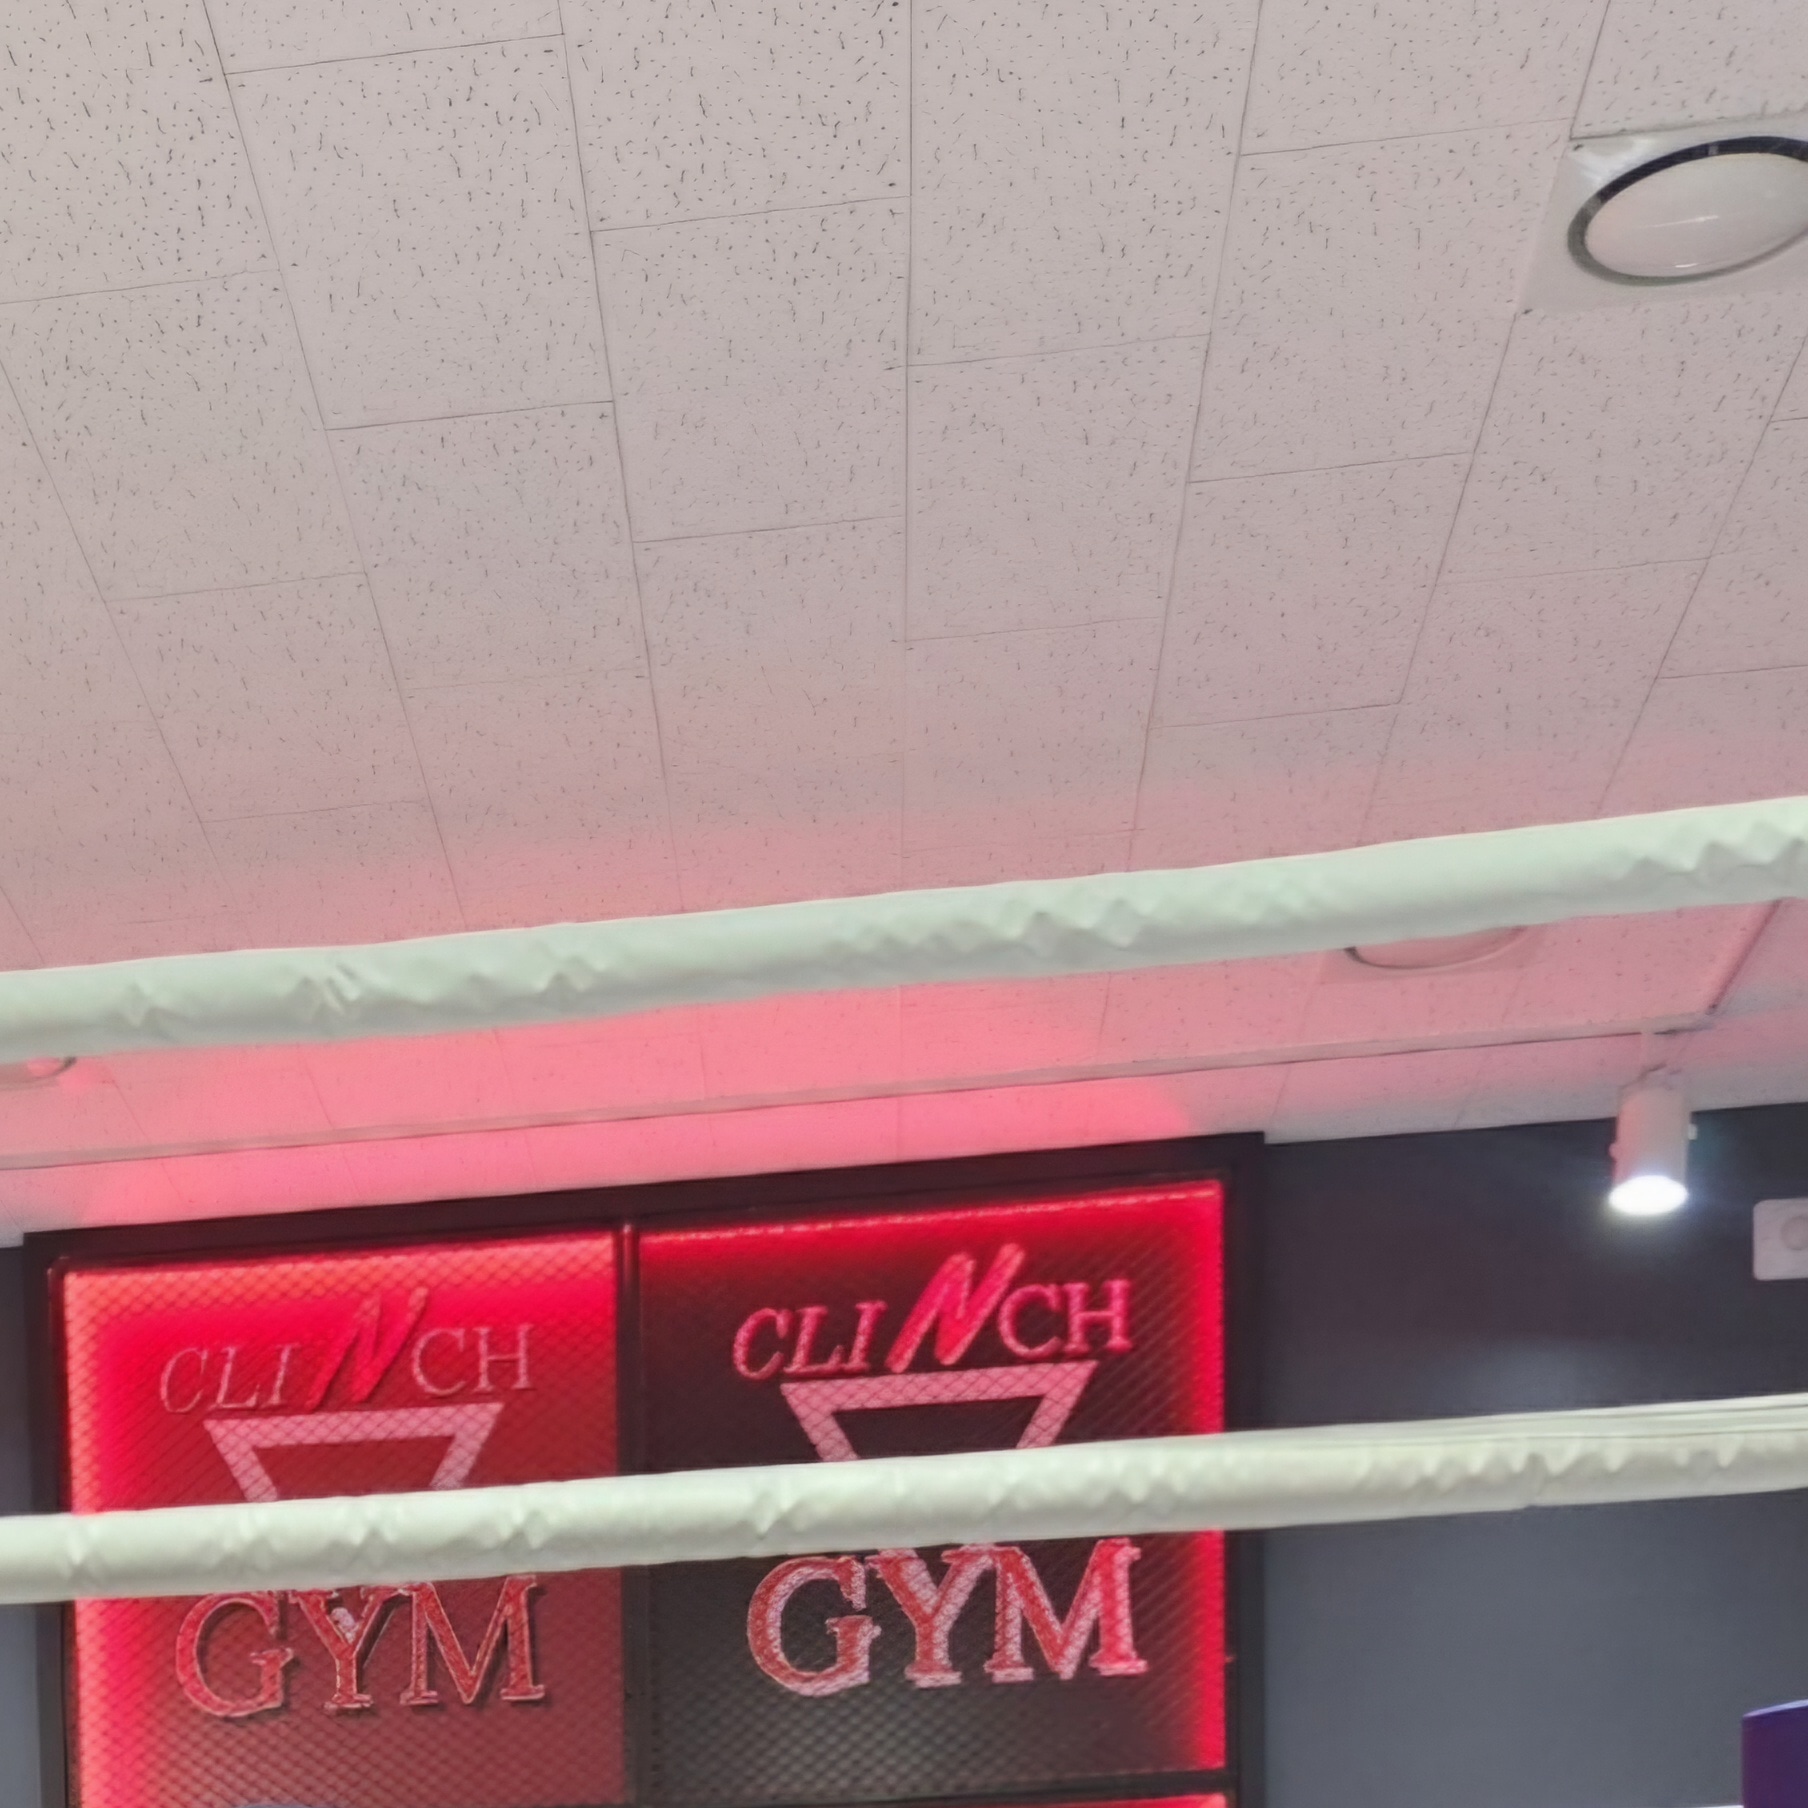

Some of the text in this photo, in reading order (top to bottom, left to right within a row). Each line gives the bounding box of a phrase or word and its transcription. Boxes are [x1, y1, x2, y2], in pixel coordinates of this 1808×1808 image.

[160, 1287, 534, 1413] CLINCH
[732, 1243, 1134, 1380] CLINCH
[175, 1576, 545, 1718] GYM
[747, 1538, 1149, 1698] GYM
